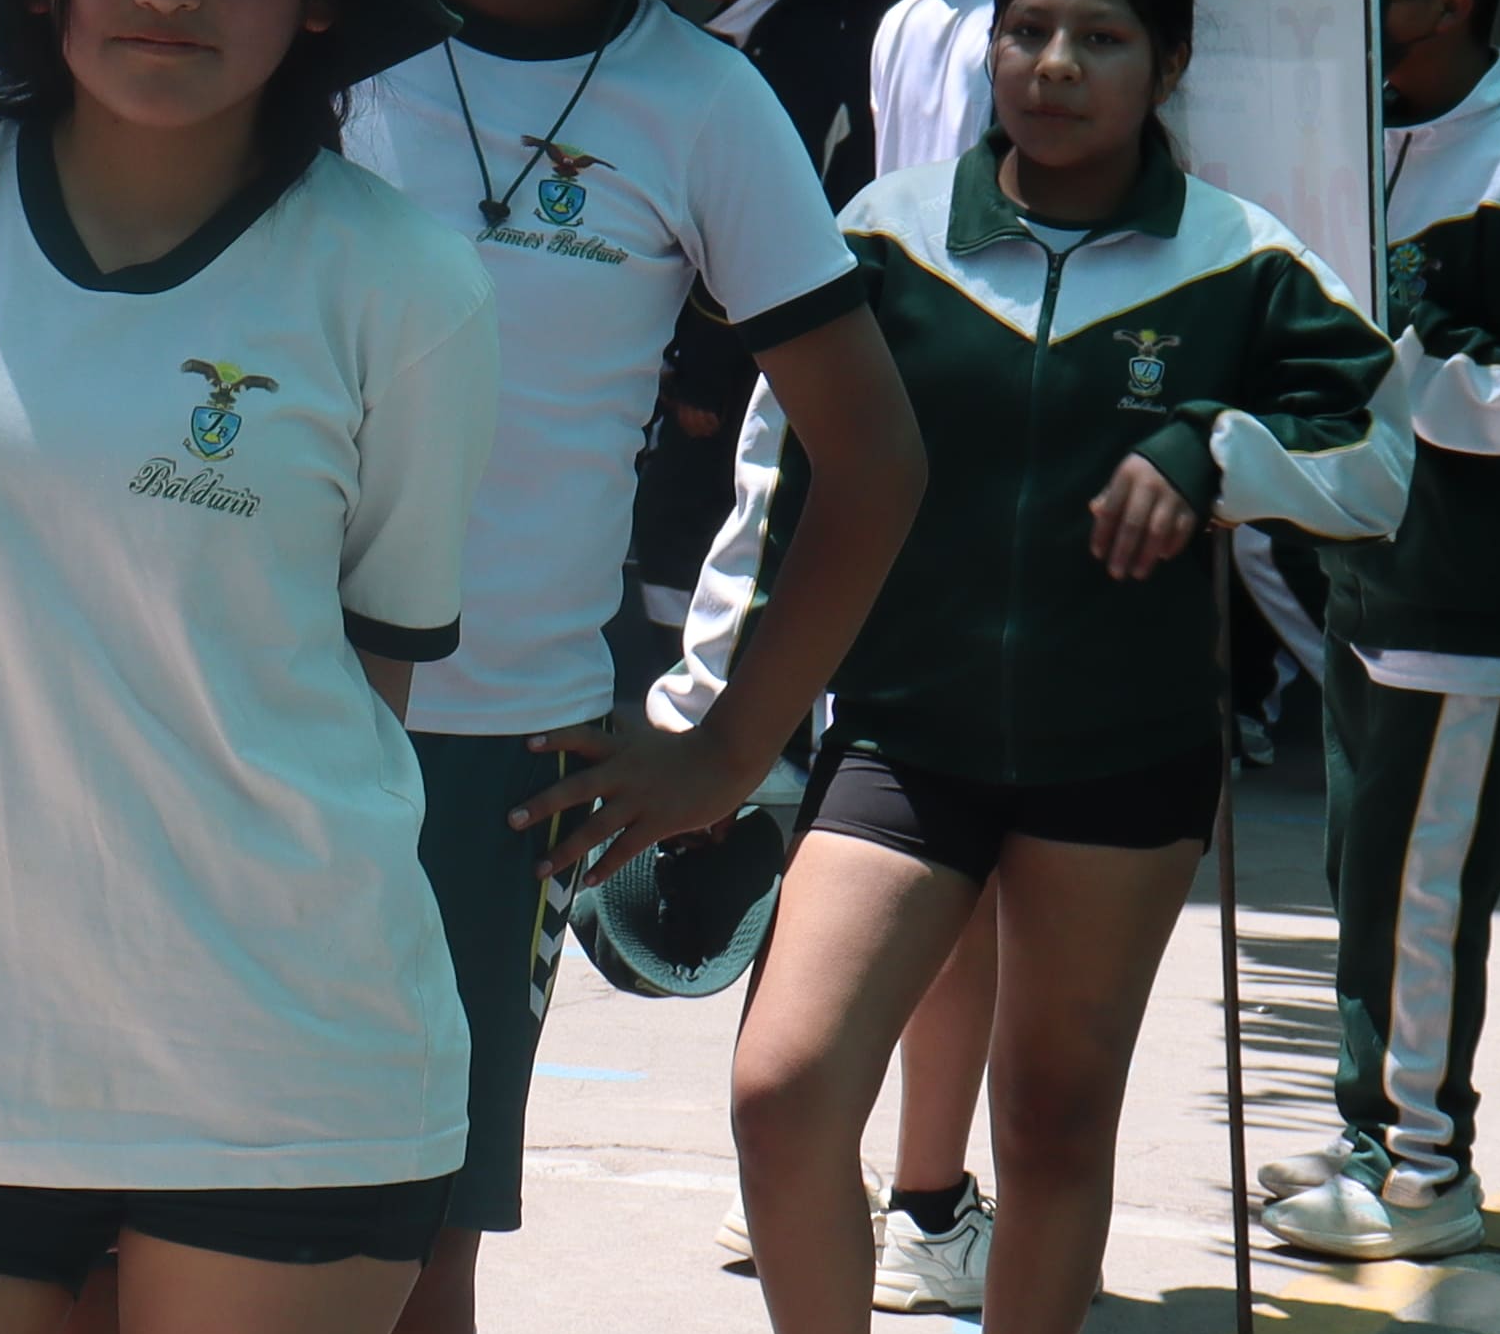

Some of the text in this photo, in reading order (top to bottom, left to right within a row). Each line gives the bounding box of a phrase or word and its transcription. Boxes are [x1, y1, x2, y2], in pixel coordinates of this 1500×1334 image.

[476, 225, 629, 265] James Baldwin
[128, 457, 261, 517] Baldwin
